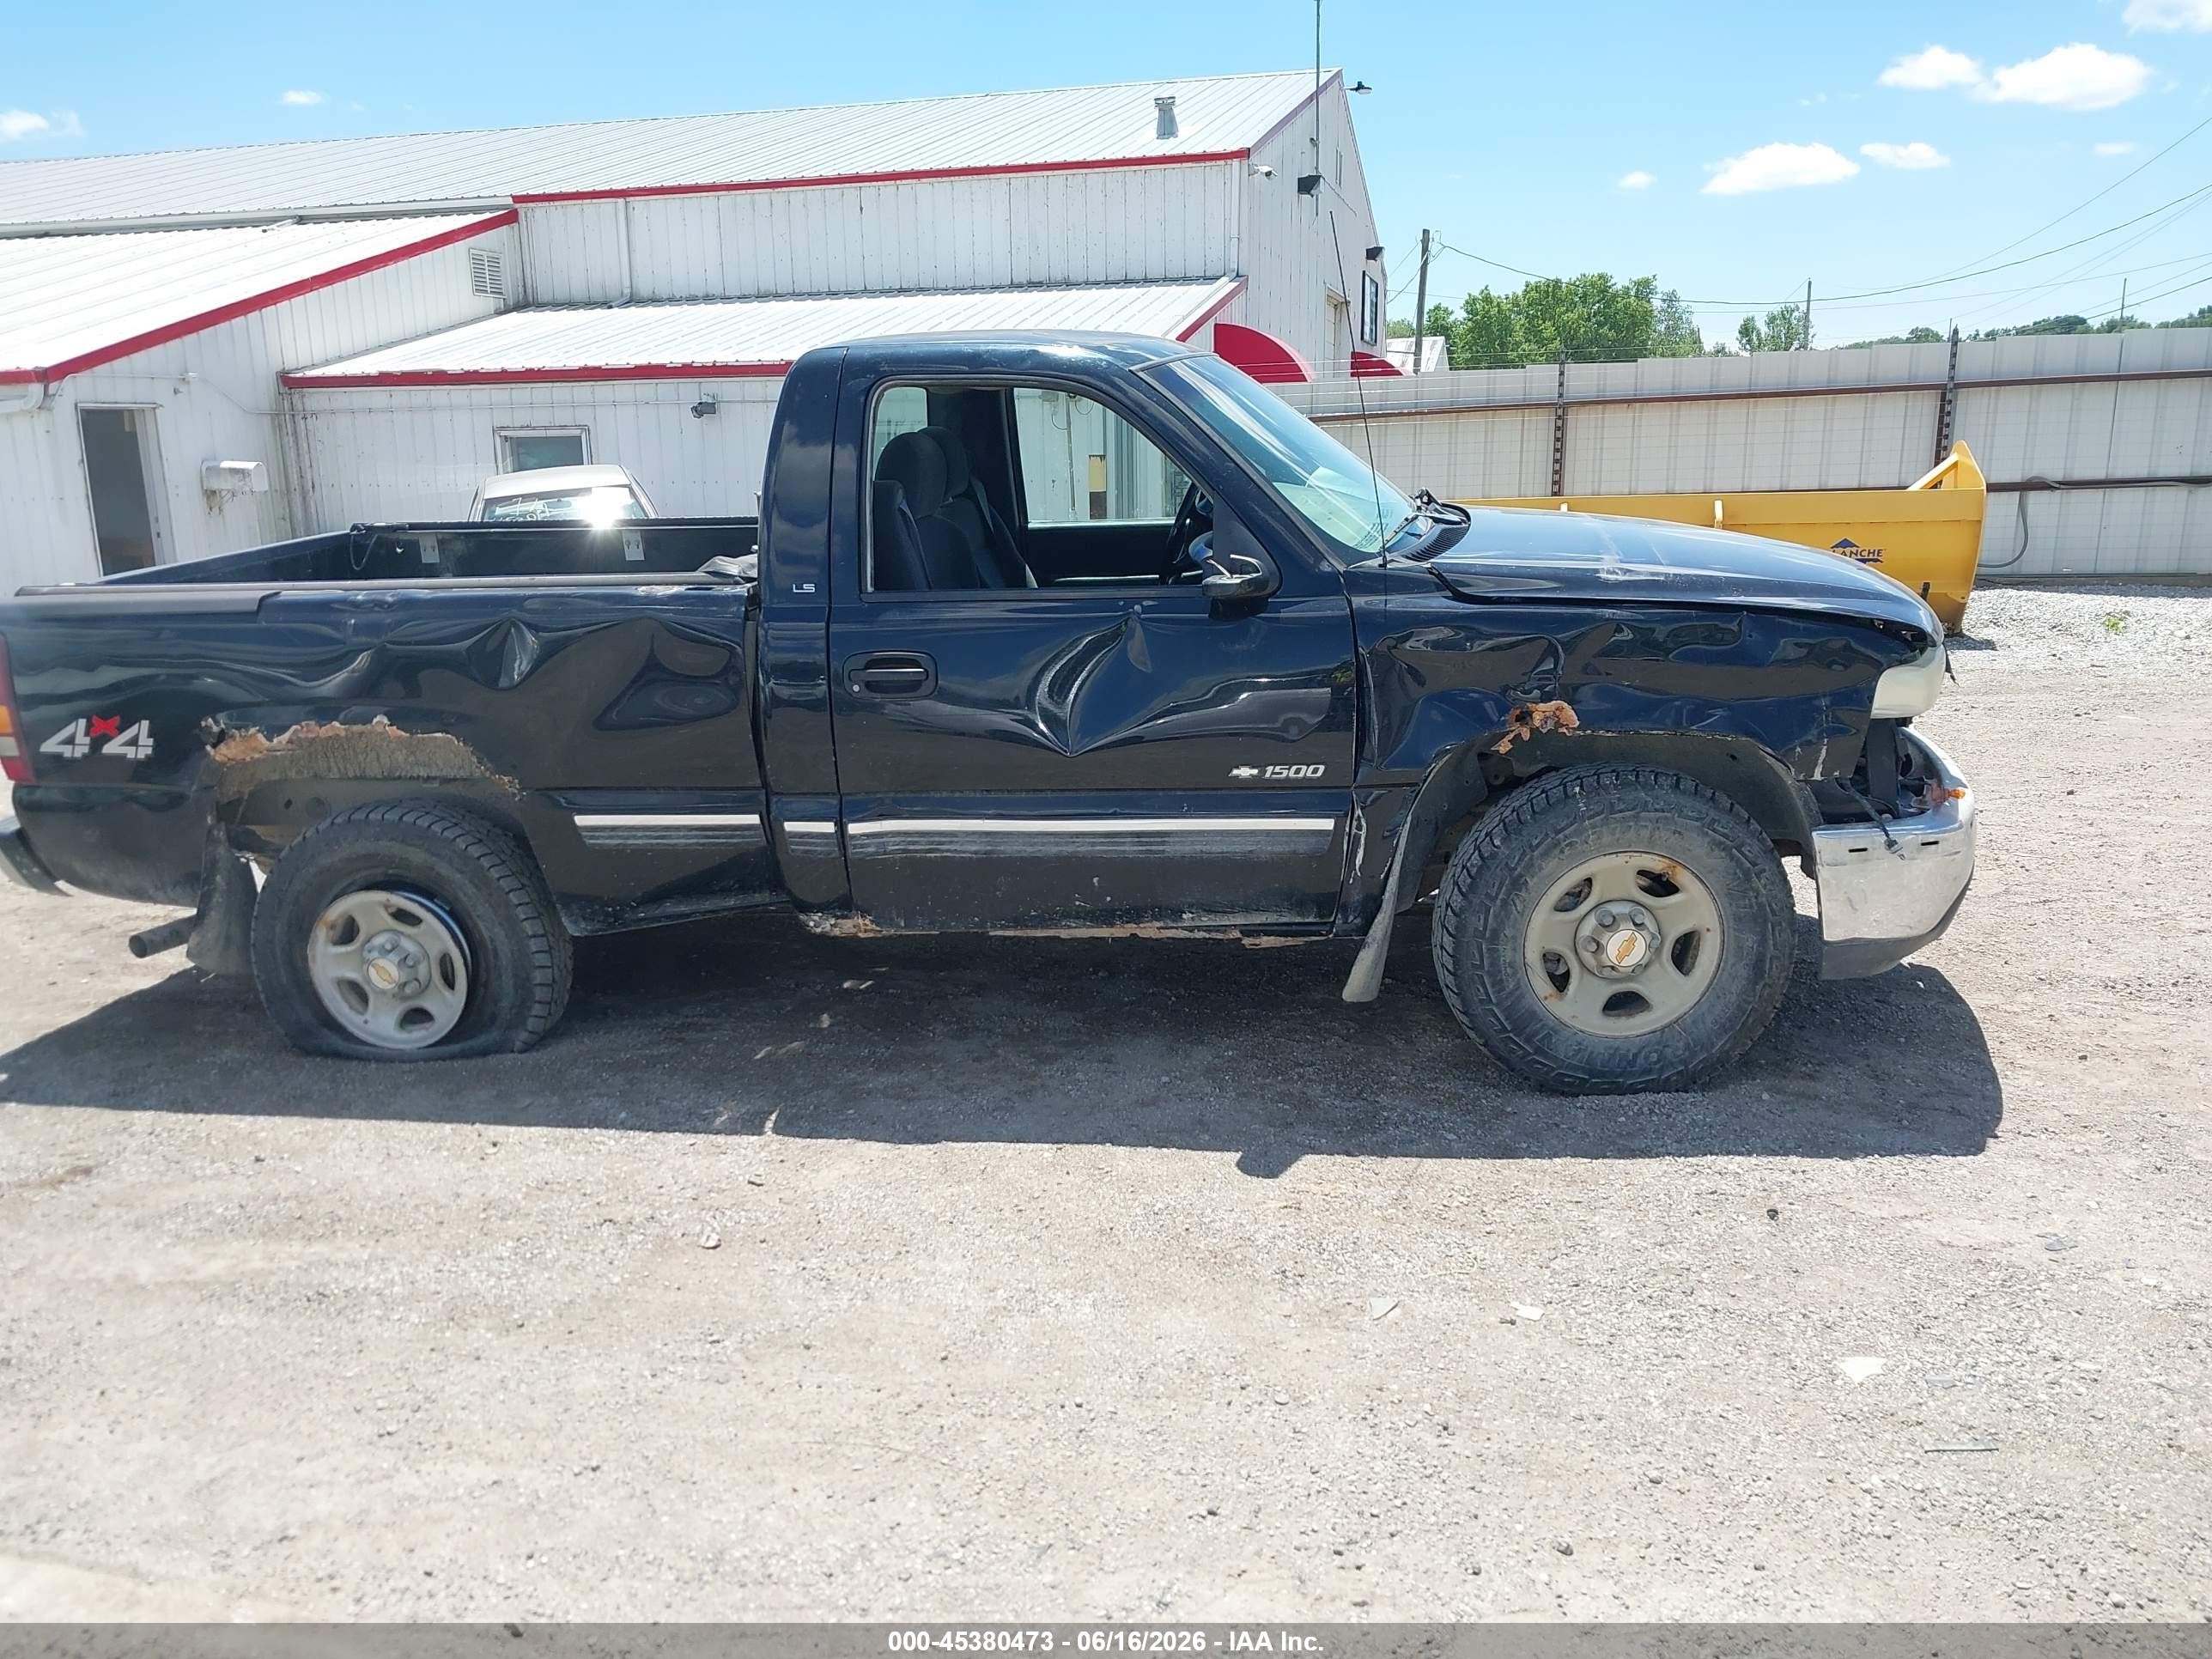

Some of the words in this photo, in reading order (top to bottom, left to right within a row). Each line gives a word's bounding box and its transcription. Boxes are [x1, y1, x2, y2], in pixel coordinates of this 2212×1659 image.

[1832, 549, 1884, 558] ANCHE
[792, 583, 816, 592] LS
[1263, 764, 1326, 778] 1500
